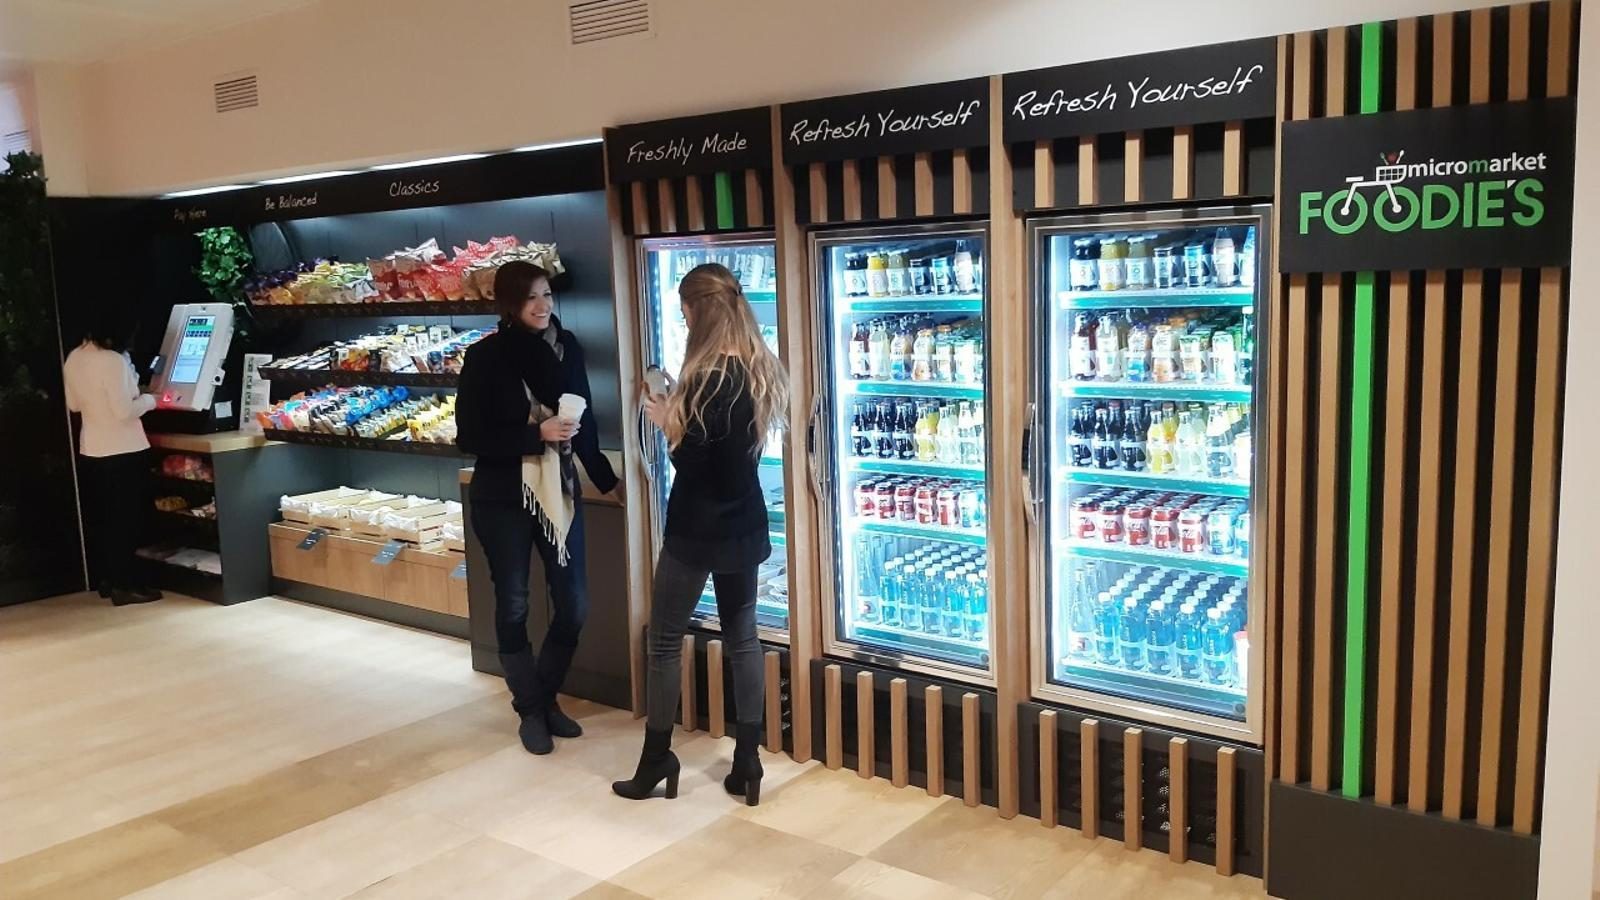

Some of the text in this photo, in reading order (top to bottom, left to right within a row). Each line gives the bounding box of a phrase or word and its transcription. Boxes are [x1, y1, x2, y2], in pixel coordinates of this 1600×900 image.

[1012, 64, 1264, 121] Refresh Yourself
[789, 100, 980, 145] Refresh Yourself
[626, 132, 747, 166] Freshly Made
[1408, 152, 1547, 178] micromarket
[265, 192, 318, 211] Be Balanced
[389, 179, 440, 197] Classics
[1299, 178, 1545, 235] FOODIE'S
